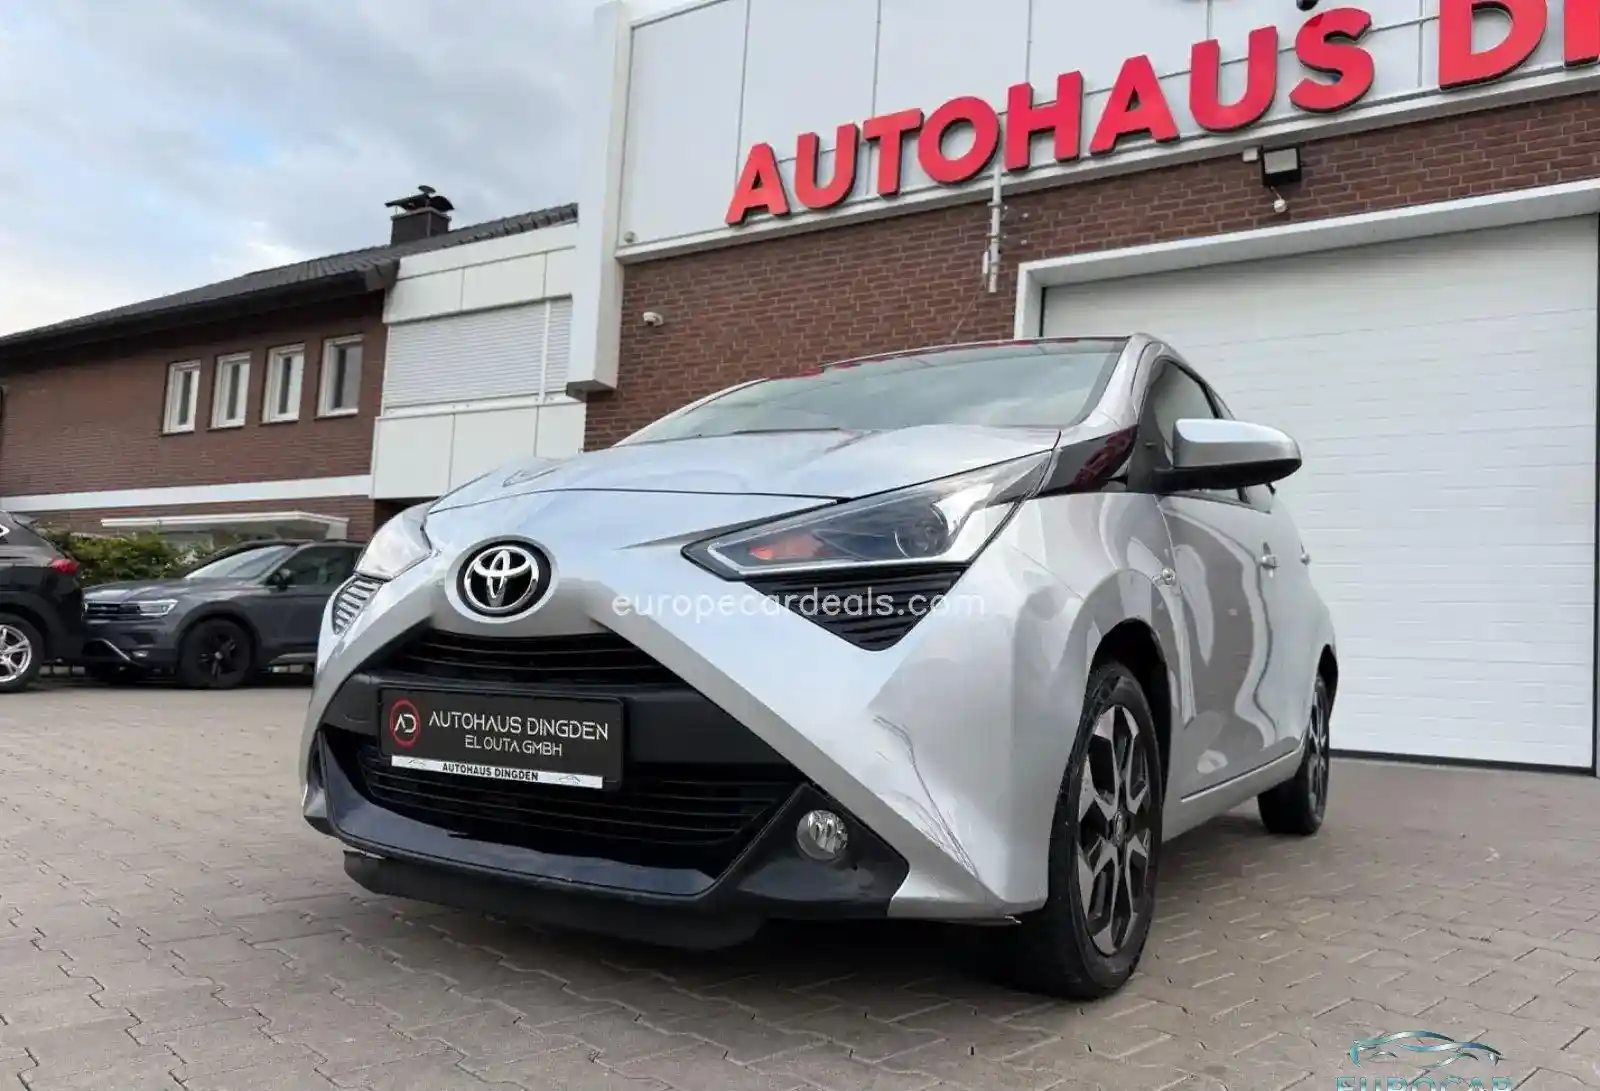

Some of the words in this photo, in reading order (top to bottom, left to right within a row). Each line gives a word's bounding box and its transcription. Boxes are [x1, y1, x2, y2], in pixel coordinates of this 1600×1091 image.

[725, 7, 1375, 226] AUTOHAUS
[428, 710, 522, 735] AUTOHAUS
[527, 717, 609, 742] DINGDEN
[465, 734, 482, 749] EL
[484, 736, 520, 753] OUTA
[522, 740, 563, 757] GMBH
[442, 762, 492, 778] AUTOHAUS
[494, 767, 539, 782] DINGDEN
